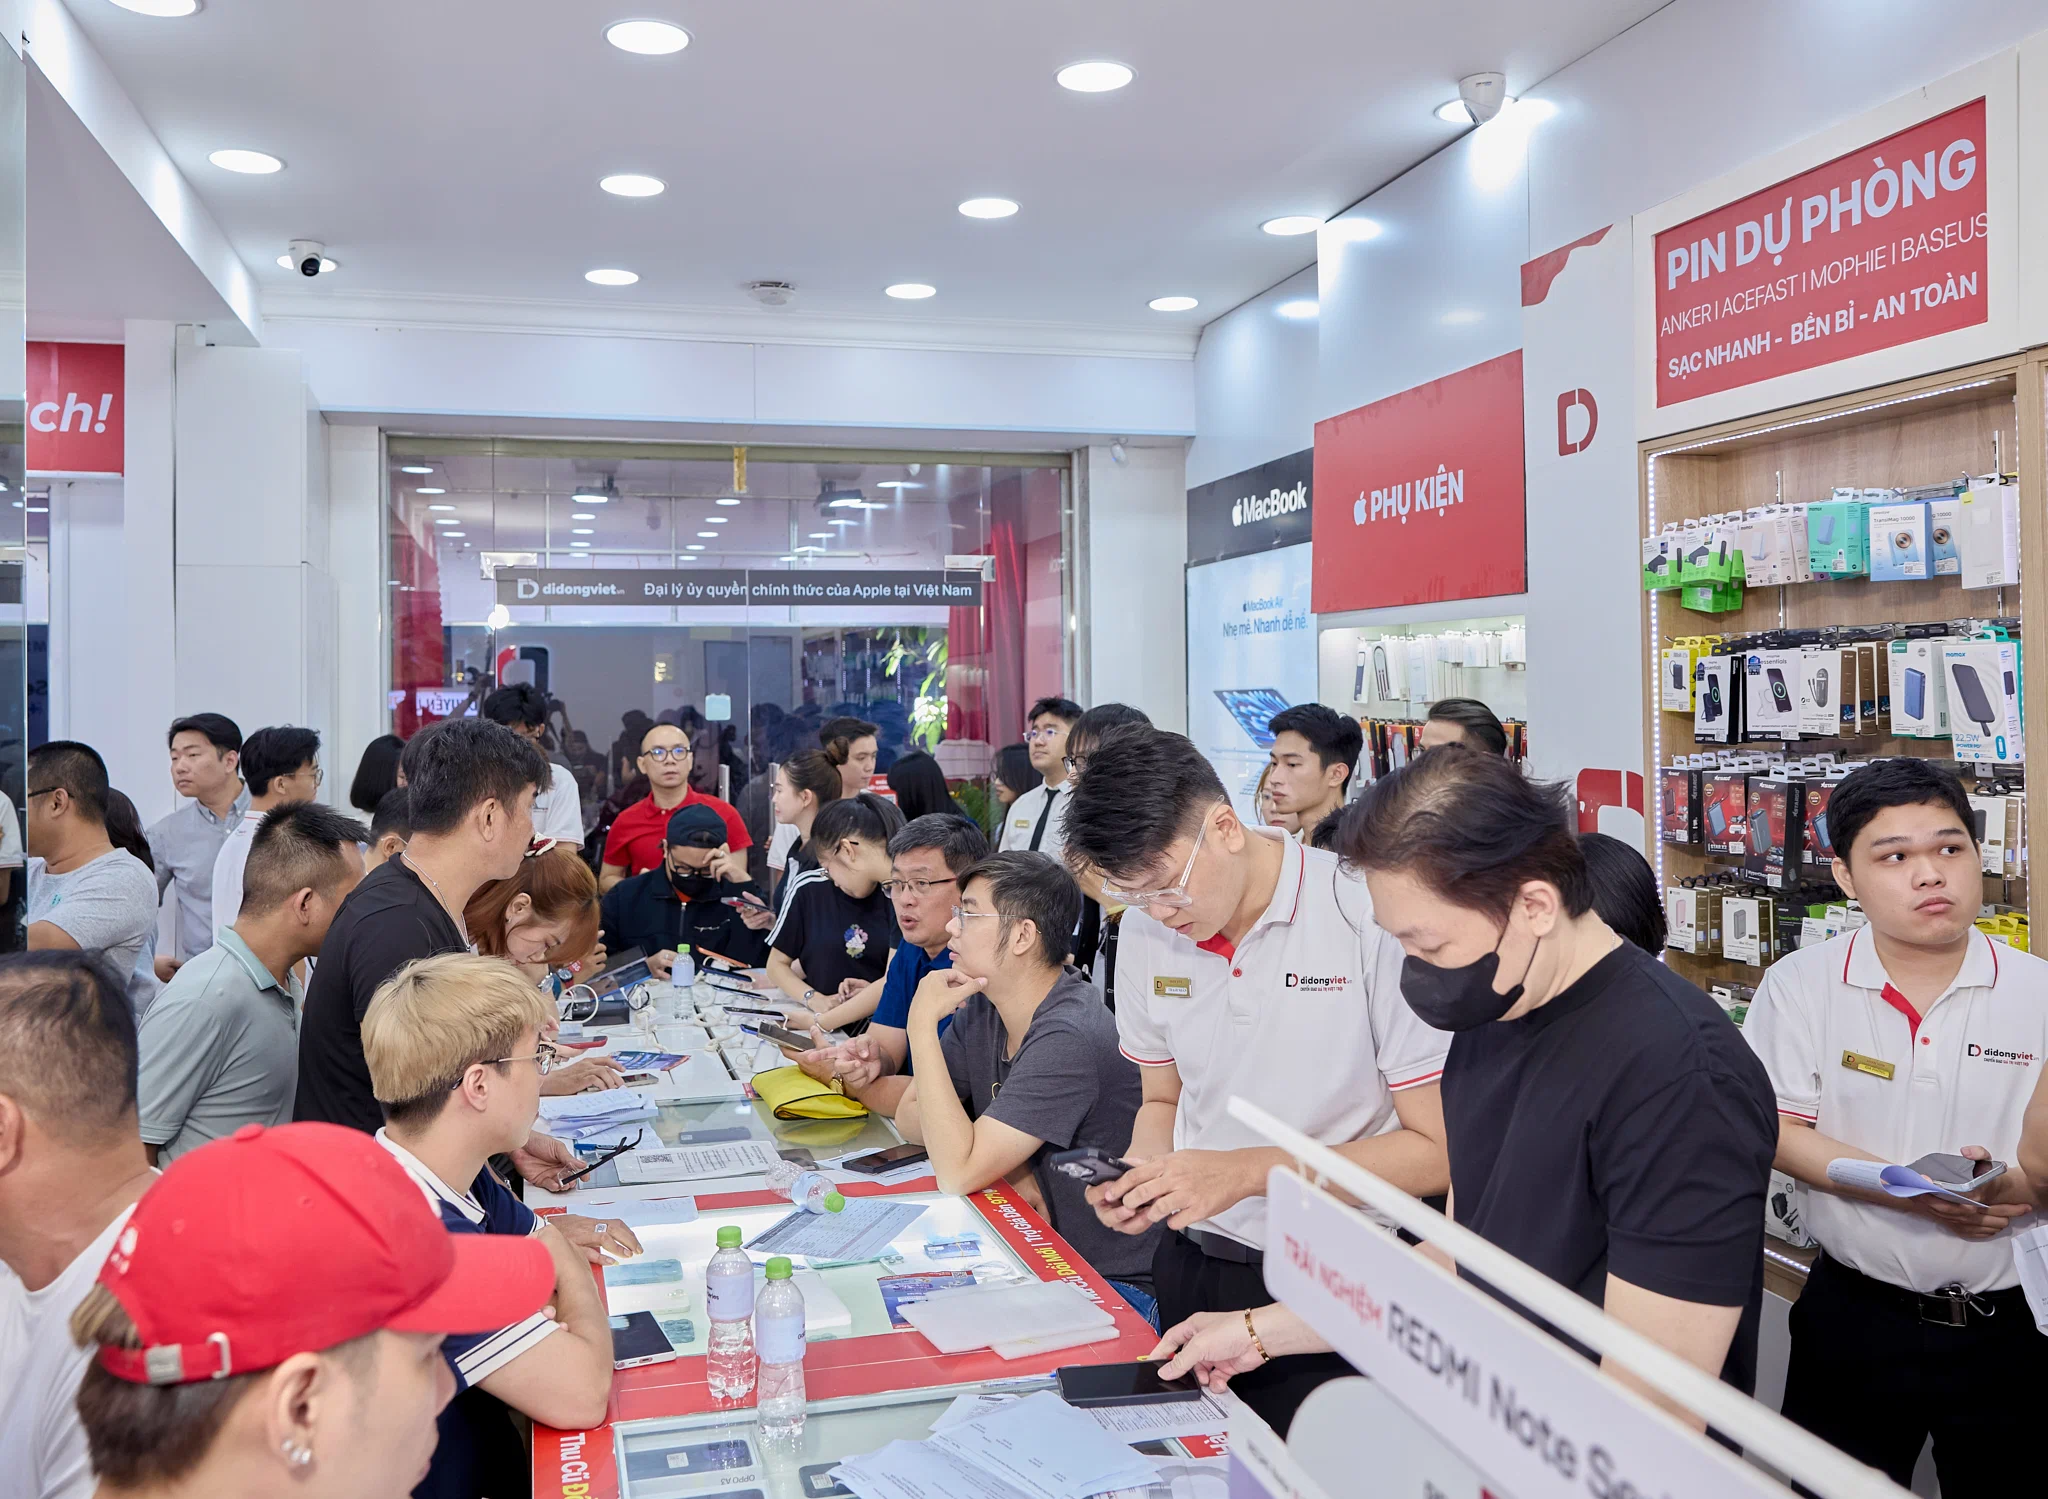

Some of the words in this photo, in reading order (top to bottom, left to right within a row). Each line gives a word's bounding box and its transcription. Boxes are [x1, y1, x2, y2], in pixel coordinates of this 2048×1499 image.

[1668, 231, 1726, 291] PIN
[1735, 196, 1793, 266] DỰ
[1802, 138, 1977, 244] PHÒNG
[1660, 303, 1712, 337] ANKER
[1721, 273, 1799, 318] ACEFAST
[1809, 245, 1887, 291] MOPHIE
[1901, 212, 1988, 262] BASEUS
[1668, 352, 1702, 380] SẠC
[1705, 331, 1770, 369] NHANH
[1791, 311, 1830, 345] BỀN
[1834, 299, 1855, 333] BỈ
[1873, 292, 1906, 323] AN
[1911, 271, 1977, 311] TOÀN
[26, 392, 113, 434] ch!
[1243, 481, 1308, 524] MacBook
[1370, 482, 1410, 524] PHỤ
[1415, 463, 1464, 517] KIỆN
[644, 582, 668, 598] Đại
[671, 582, 684, 598] lý
[687, 581, 703, 598] ủy
[706, 580, 747, 598] quyền
[752, 583, 790, 597] chính
[793, 583, 824, 597] thức
[826, 583, 850, 597] của
[853, 584, 891, 599] Apple
[894, 584, 911, 599] tại
[913, 583, 939, 599] Việt
[942, 584, 972, 597] Nam
[1247, 598, 1275, 611] MacBook
[1222, 622, 1238, 641] Nhẹ
[1254, 616, 1281, 634] Nhanh
[1955, 734, 1980, 742] 22.5W
[993, 1203, 1017, 1218] Đến
[1006, 1217, 1032, 1233] Giá
[1024, 1229, 1044, 1243] Trợ
[1034, 1246, 1064, 1264] Mới
[1046, 1260, 1077, 1277] Đổi
[1388, 1301, 1481, 1407] REDMI
[1489, 1371, 1580, 1481] Note
[559, 1432, 586, 1461] Thu
[561, 1461, 590, 1483] Cũ
[732, 1474, 756, 1484] OPPO
